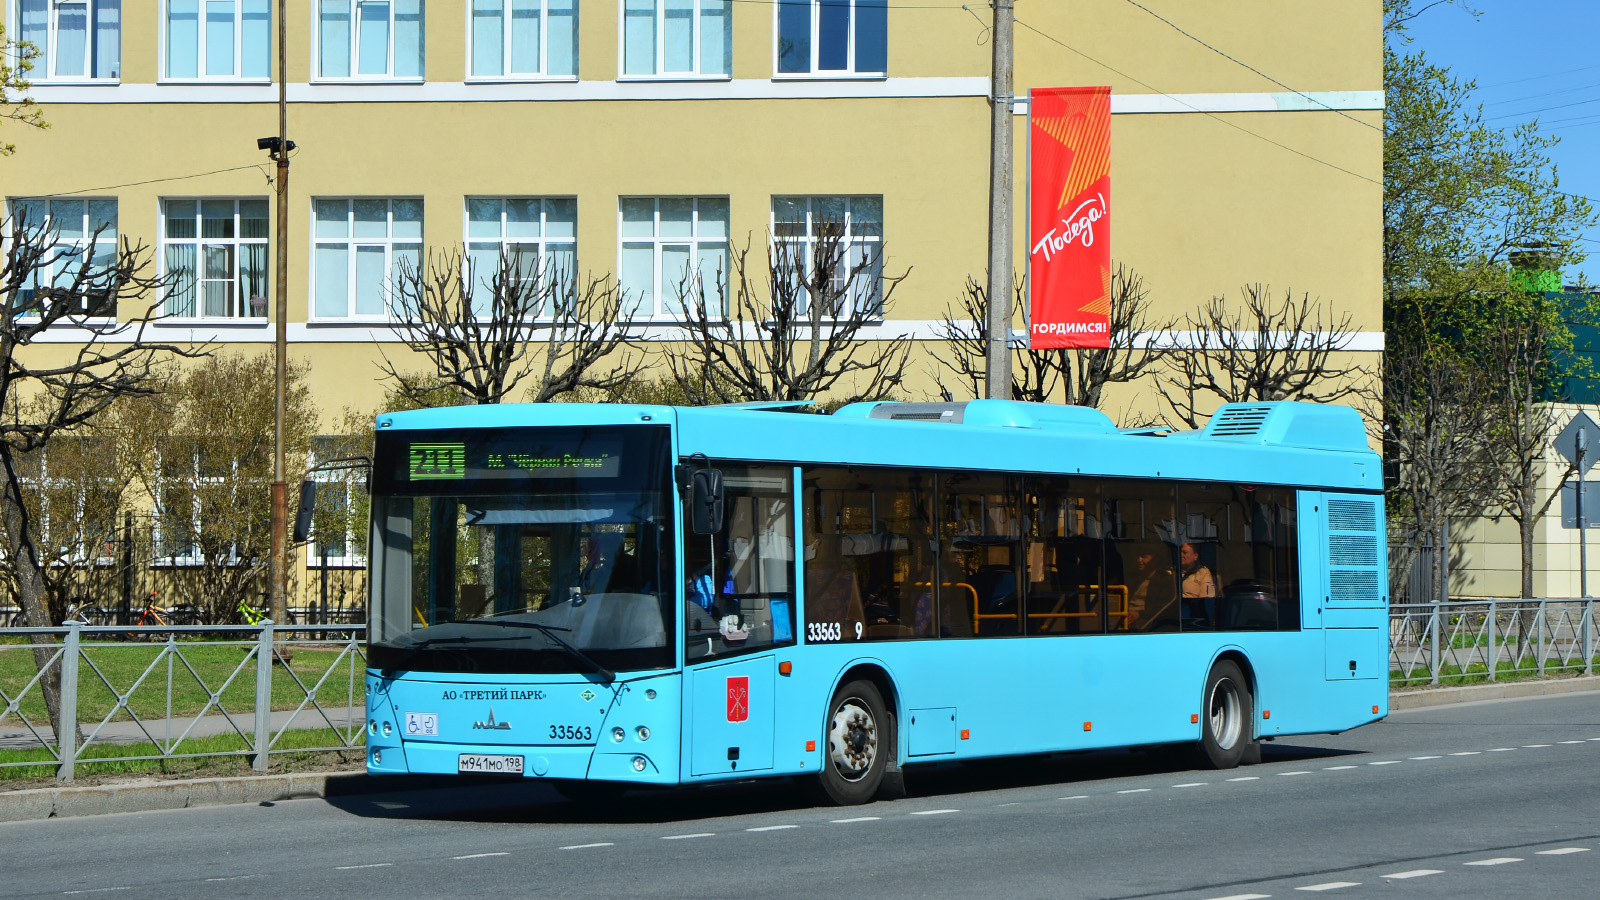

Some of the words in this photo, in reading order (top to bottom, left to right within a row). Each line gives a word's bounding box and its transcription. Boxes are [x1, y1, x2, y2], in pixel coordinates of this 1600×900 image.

[1032, 192, 1107, 262] Победа!
[1032, 322, 1107, 335] ГОРДИМСЯ!
[414, 449, 458, 475] 211
[808, 622, 842, 641] 33563
[855, 621, 863, 640] 9
[442, 690, 457, 700] АО
[459, 687, 508, 700] «ТРЕТИЙ
[510, 690, 547, 700] ПАРК»
[549, 724, 592, 741] 33563
